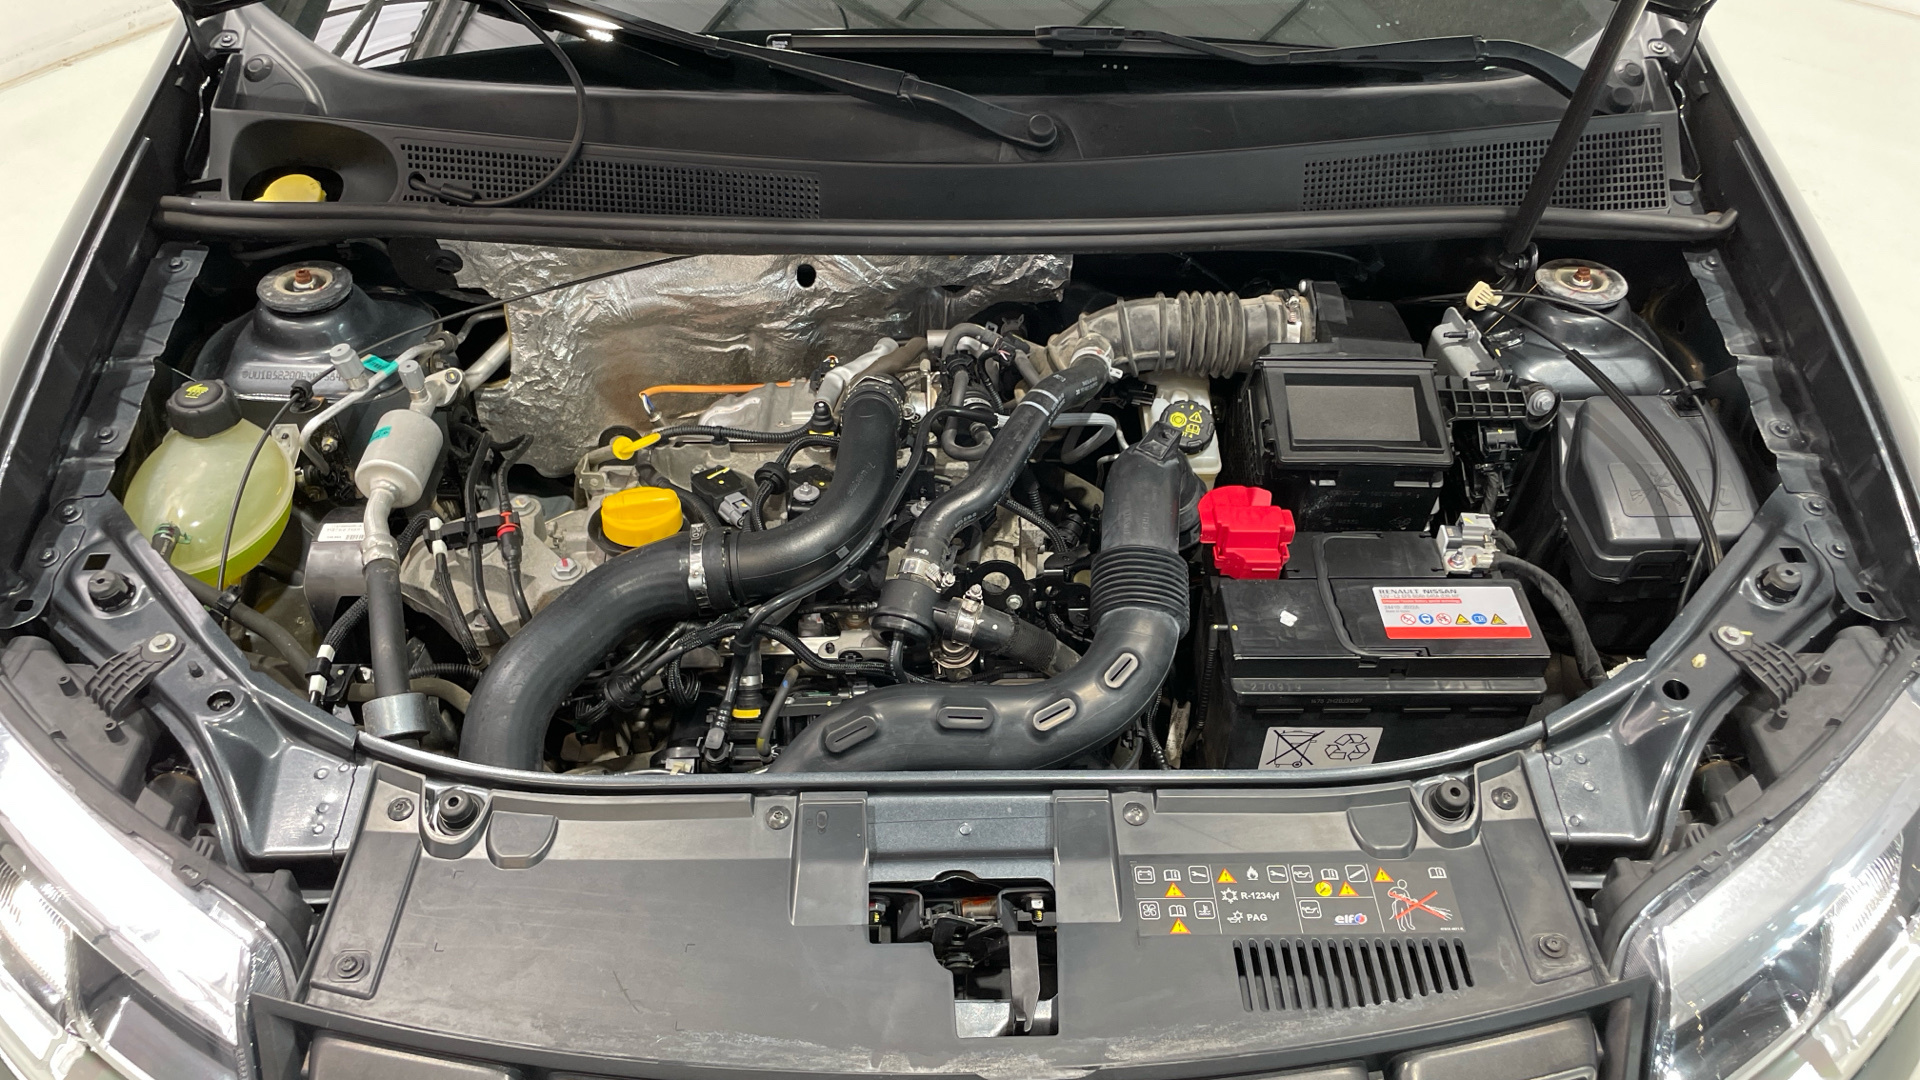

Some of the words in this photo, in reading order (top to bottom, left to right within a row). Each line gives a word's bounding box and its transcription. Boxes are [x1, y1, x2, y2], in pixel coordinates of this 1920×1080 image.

[1240, 891, 1280, 901] R-1234yf
[1246, 913, 1268, 922] PAG
[1334, 913, 1355, 924] elf
